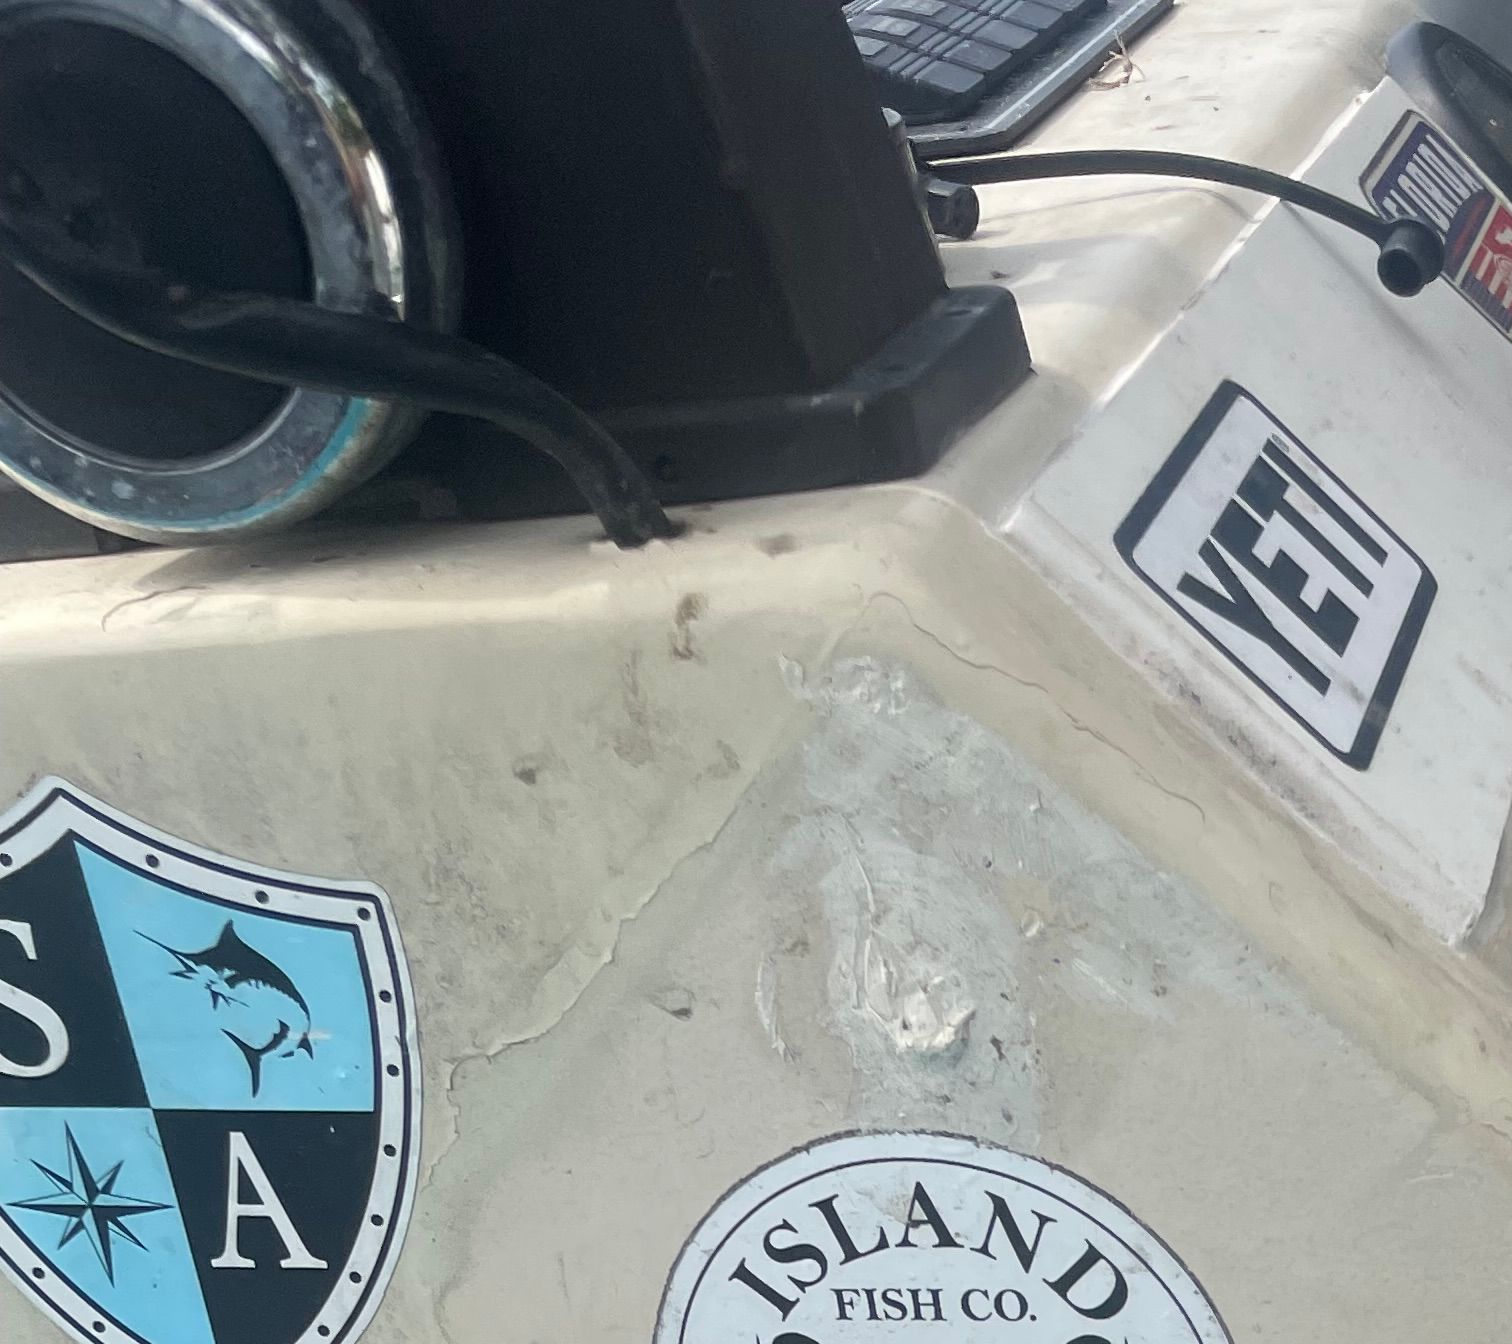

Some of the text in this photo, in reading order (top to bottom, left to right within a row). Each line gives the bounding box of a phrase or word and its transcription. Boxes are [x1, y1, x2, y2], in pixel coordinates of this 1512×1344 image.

[1177, 436, 1387, 696] YETI
[211, 1131, 329, 1270] A
[727, 1181, 1129, 1322] ISLAND
[832, 1288, 1037, 1321] FISH CO.
